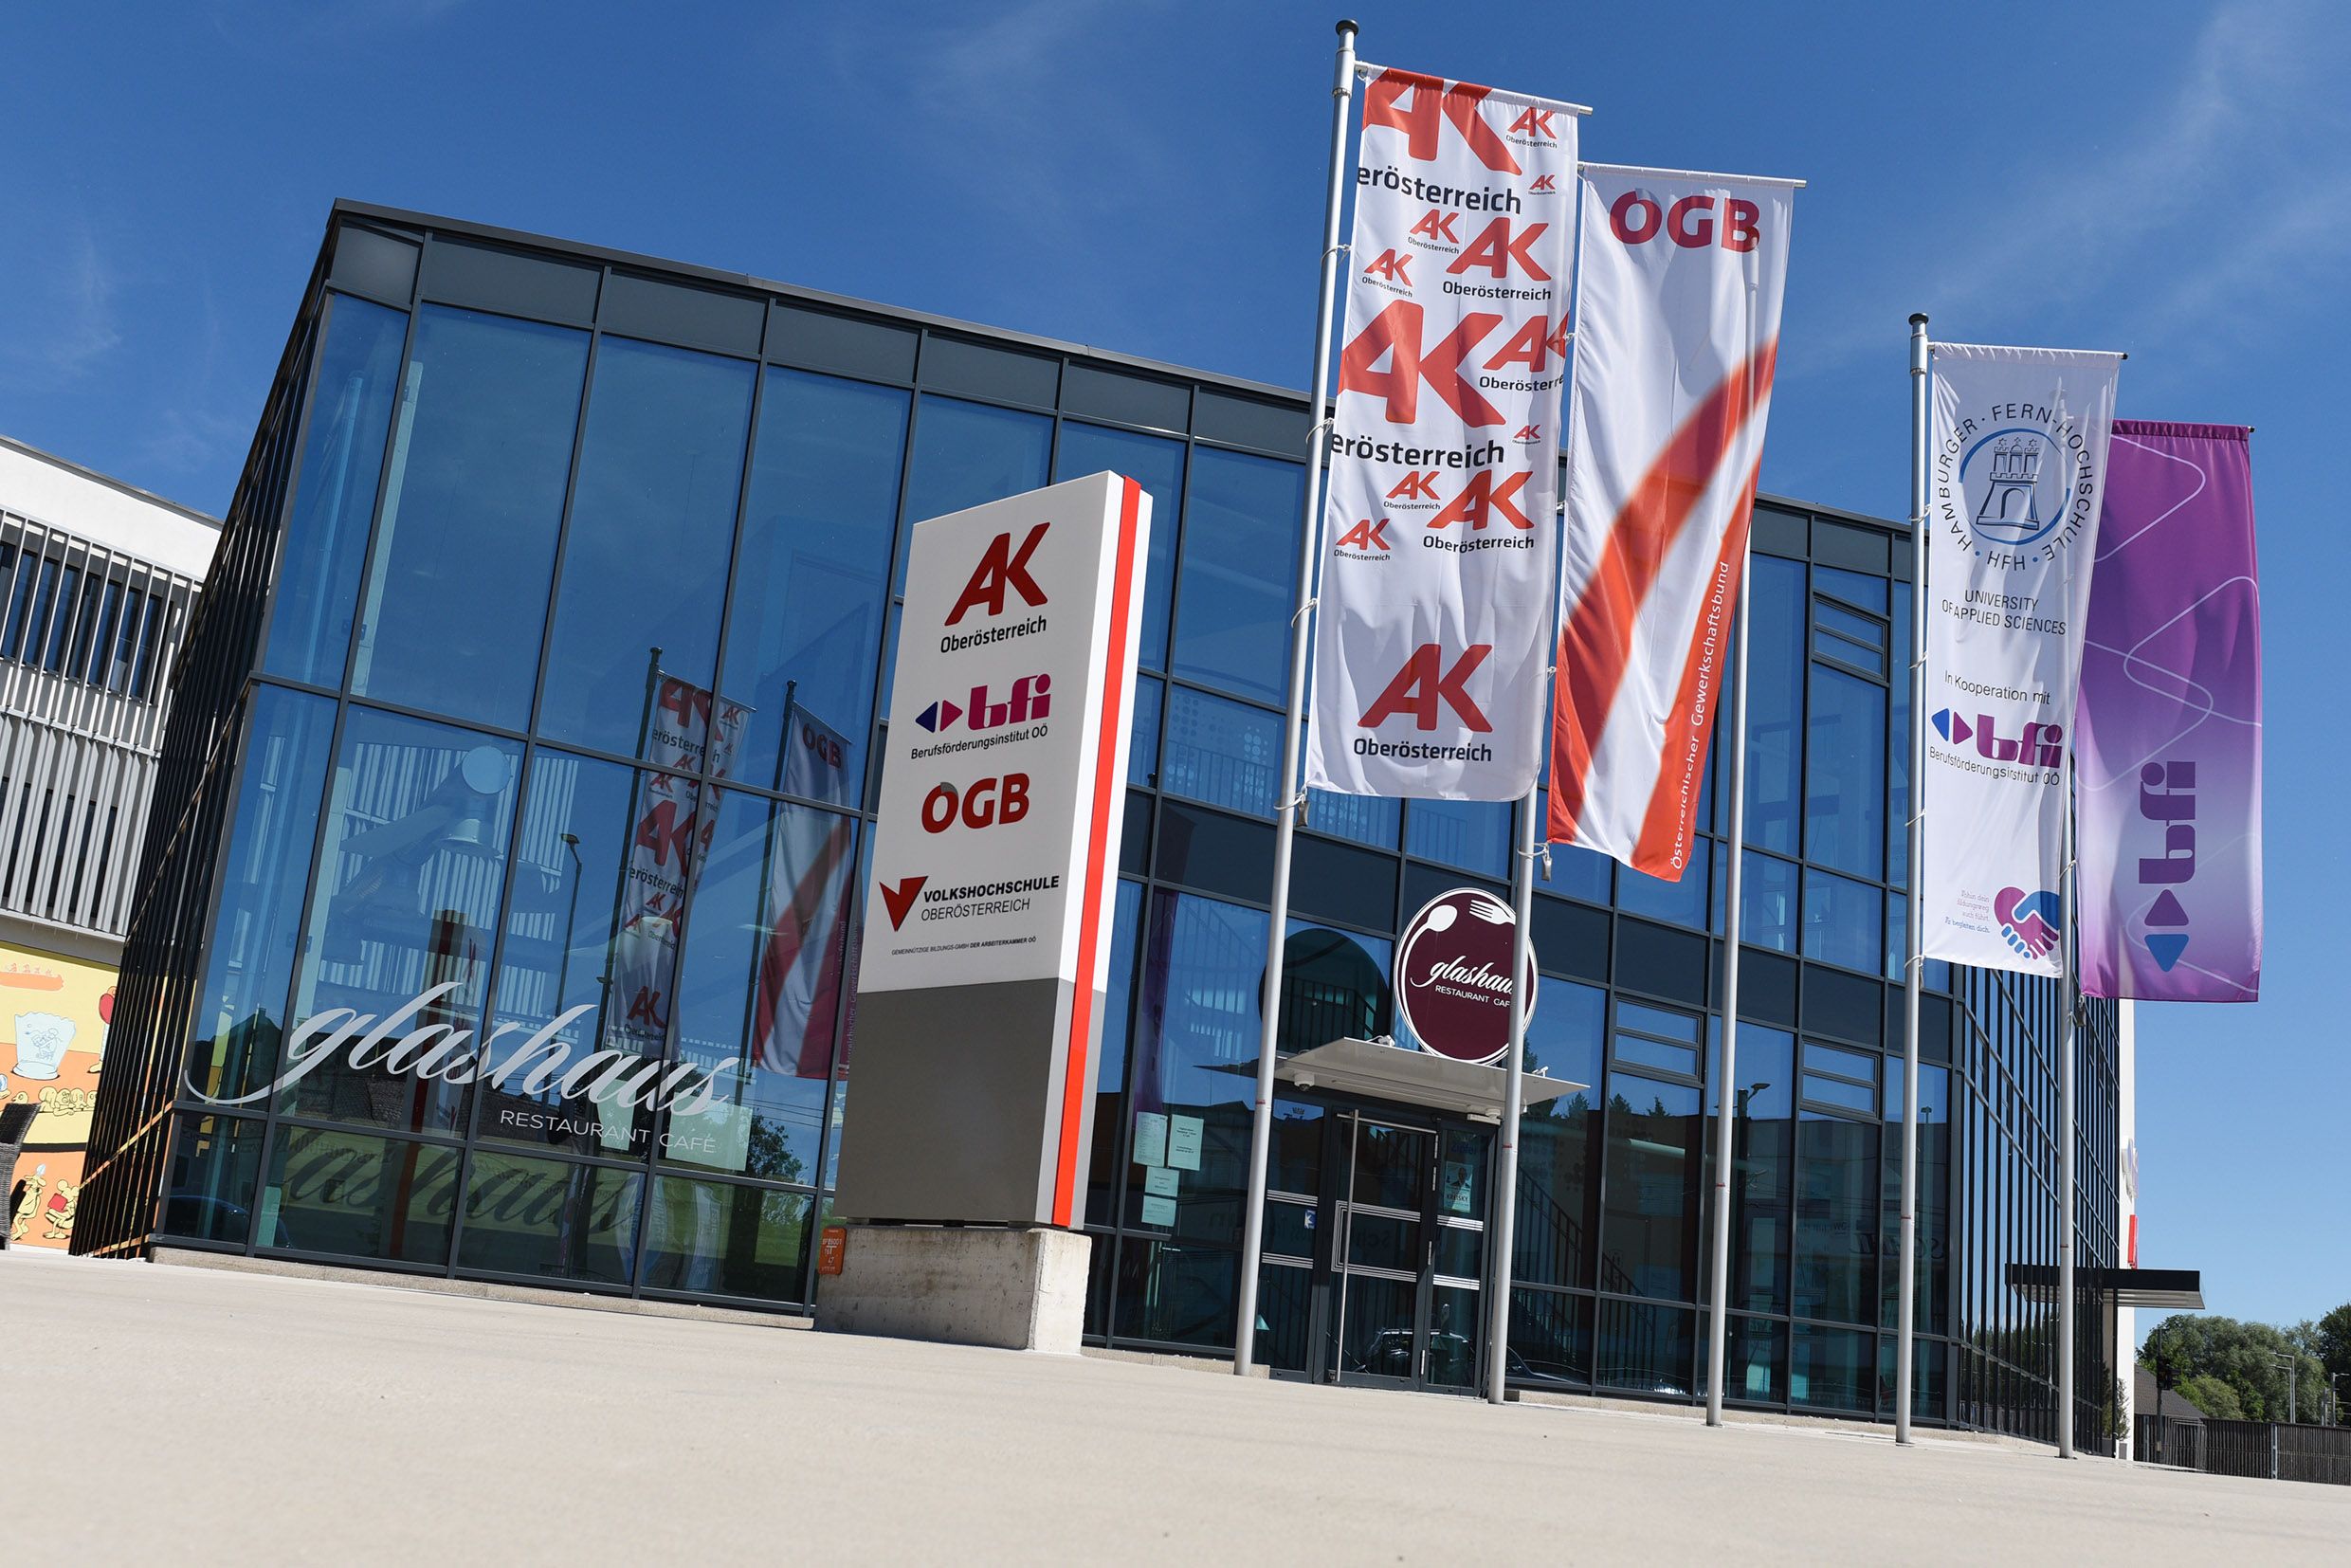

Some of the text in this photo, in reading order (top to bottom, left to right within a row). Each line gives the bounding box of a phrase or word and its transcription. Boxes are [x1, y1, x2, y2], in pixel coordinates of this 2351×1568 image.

[1362, 67, 1522, 175] AK
[1507, 106, 1557, 139] AK
[1505, 135, 1558, 149] Oberösterreich
[1528, 174, 1556, 191] AK
[1410, 209, 1460, 244] AK
[1407, 236, 1460, 255] Oberösterreich
[1446, 216, 1552, 282] AK
[1364, 248, 1413, 287] AK
[1361, 276, 1413, 298] Oberösterreich
[1442, 281, 1552, 301] Oberösterreich
[1338, 299, 1506, 428] AK
[1513, 425, 1541, 440] AK
[1386, 470, 1441, 501] AK
[1426, 469, 1535, 530] AK
[1938, 417, 1978, 551] HAMBURGER
[1383, 501, 1441, 510] Oberösterreich
[1336, 519, 1391, 551] AK
[1423, 536, 1535, 554] Oberösterreich
[1334, 548, 1391, 561] Oberösterreich
[1987, 550, 2026, 571] HFH
[944, 521, 1050, 627] AK
[1941, 599, 2067, 635] OF APPLIED SCIENCES
[1964, 590, 2039, 611] UNIVERSITY
[940, 615, 1047, 653] Oberösterreich
[968, 673, 1051, 730] bfi
[1358, 643, 1493, 733] AK
[1944, 670, 2050, 705] In Kooperation mit
[1670, 560, 1729, 869] Österreichischer Gewerkschaftsbund
[911, 723, 1048, 759] Berufsförderungsinstitut OÖ
[1354, 738, 1492, 762] Oberösterreich
[1977, 714, 2063, 769] bfi
[2139, 761, 2196, 884] bfi
[924, 875, 1060, 903] VOLKSHOCHSCHULE
[920, 898, 1031, 921] OBERÖSTERREICH
[981, 938, 1027, 947] ARBEITERKAMMER
[1410, 956, 1513, 994] glashau
[1435, 985, 1511, 1008] RESTAURANT CAF
[184, 981, 741, 1117] glashaus
[501, 1109, 651, 1143] RESTAURANT
